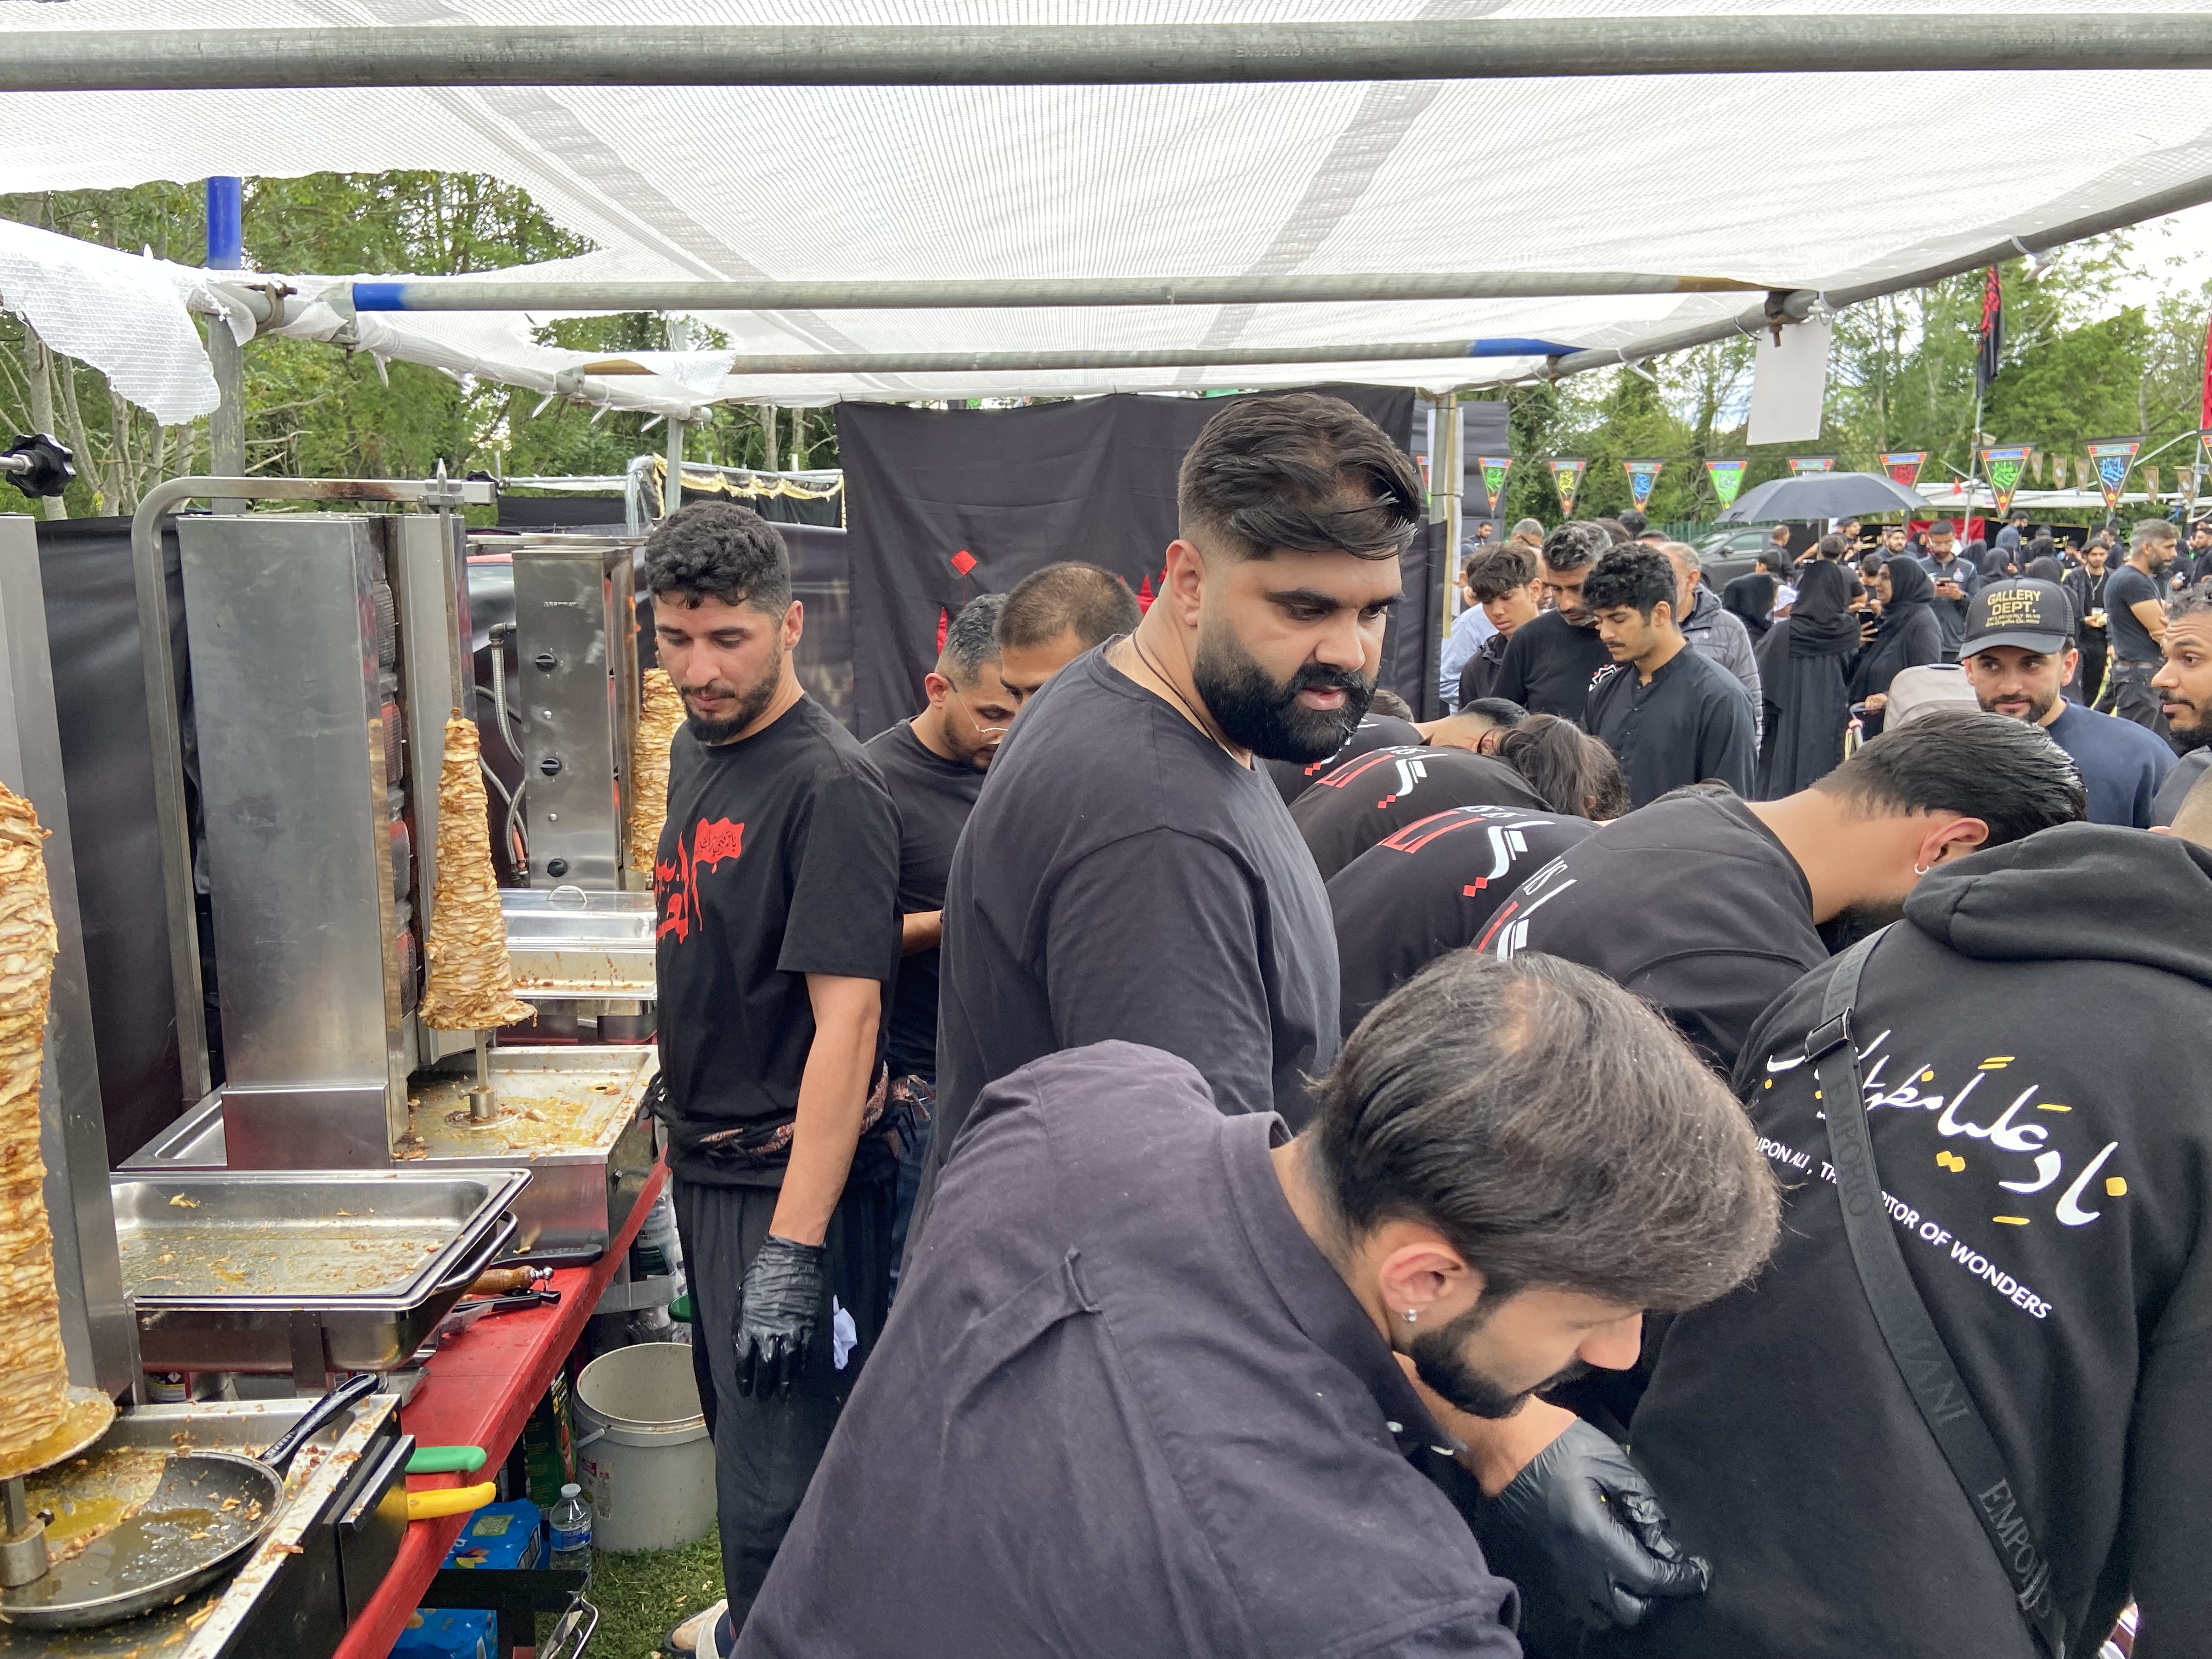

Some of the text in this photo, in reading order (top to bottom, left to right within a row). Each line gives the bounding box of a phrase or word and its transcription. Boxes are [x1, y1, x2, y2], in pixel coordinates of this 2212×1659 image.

[1236, 44, 1269, 58] EN39
[1987, 589, 2041, 606] GALLERY
[1991, 601, 2036, 616] DEPT.
[1920, 1222, 1952, 1246] OF
[1950, 1240, 2052, 1318] WONDERS
